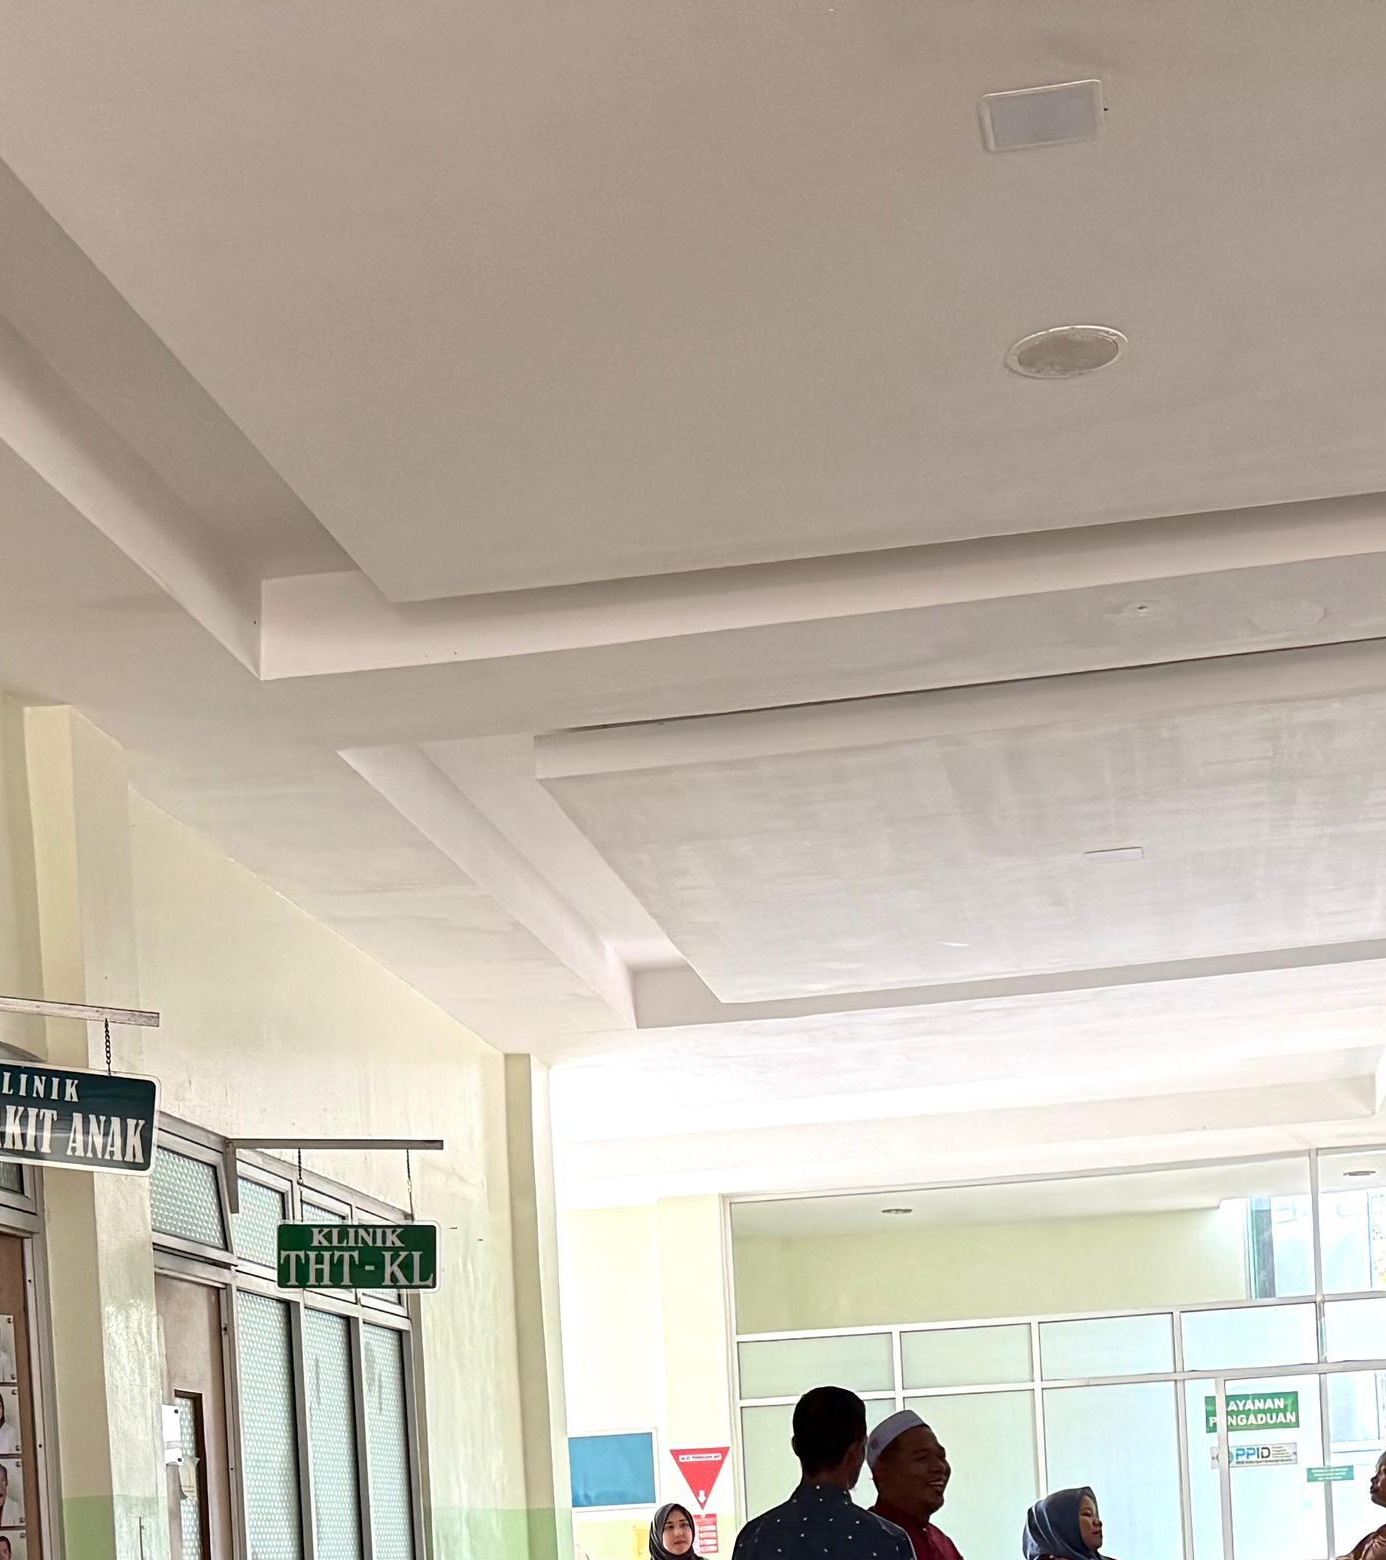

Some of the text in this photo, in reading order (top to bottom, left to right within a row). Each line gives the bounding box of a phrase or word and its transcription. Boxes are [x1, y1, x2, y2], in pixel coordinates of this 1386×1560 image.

[66, 1112, 147, 1164] ANAK
[310, 1227, 406, 1248] KLINIK
[1226, 1397, 1285, 1411] AYANAN
[1209, 1411, 1296, 1427] PNGADUAN
[1235, 1447, 1271, 1460] PPID
